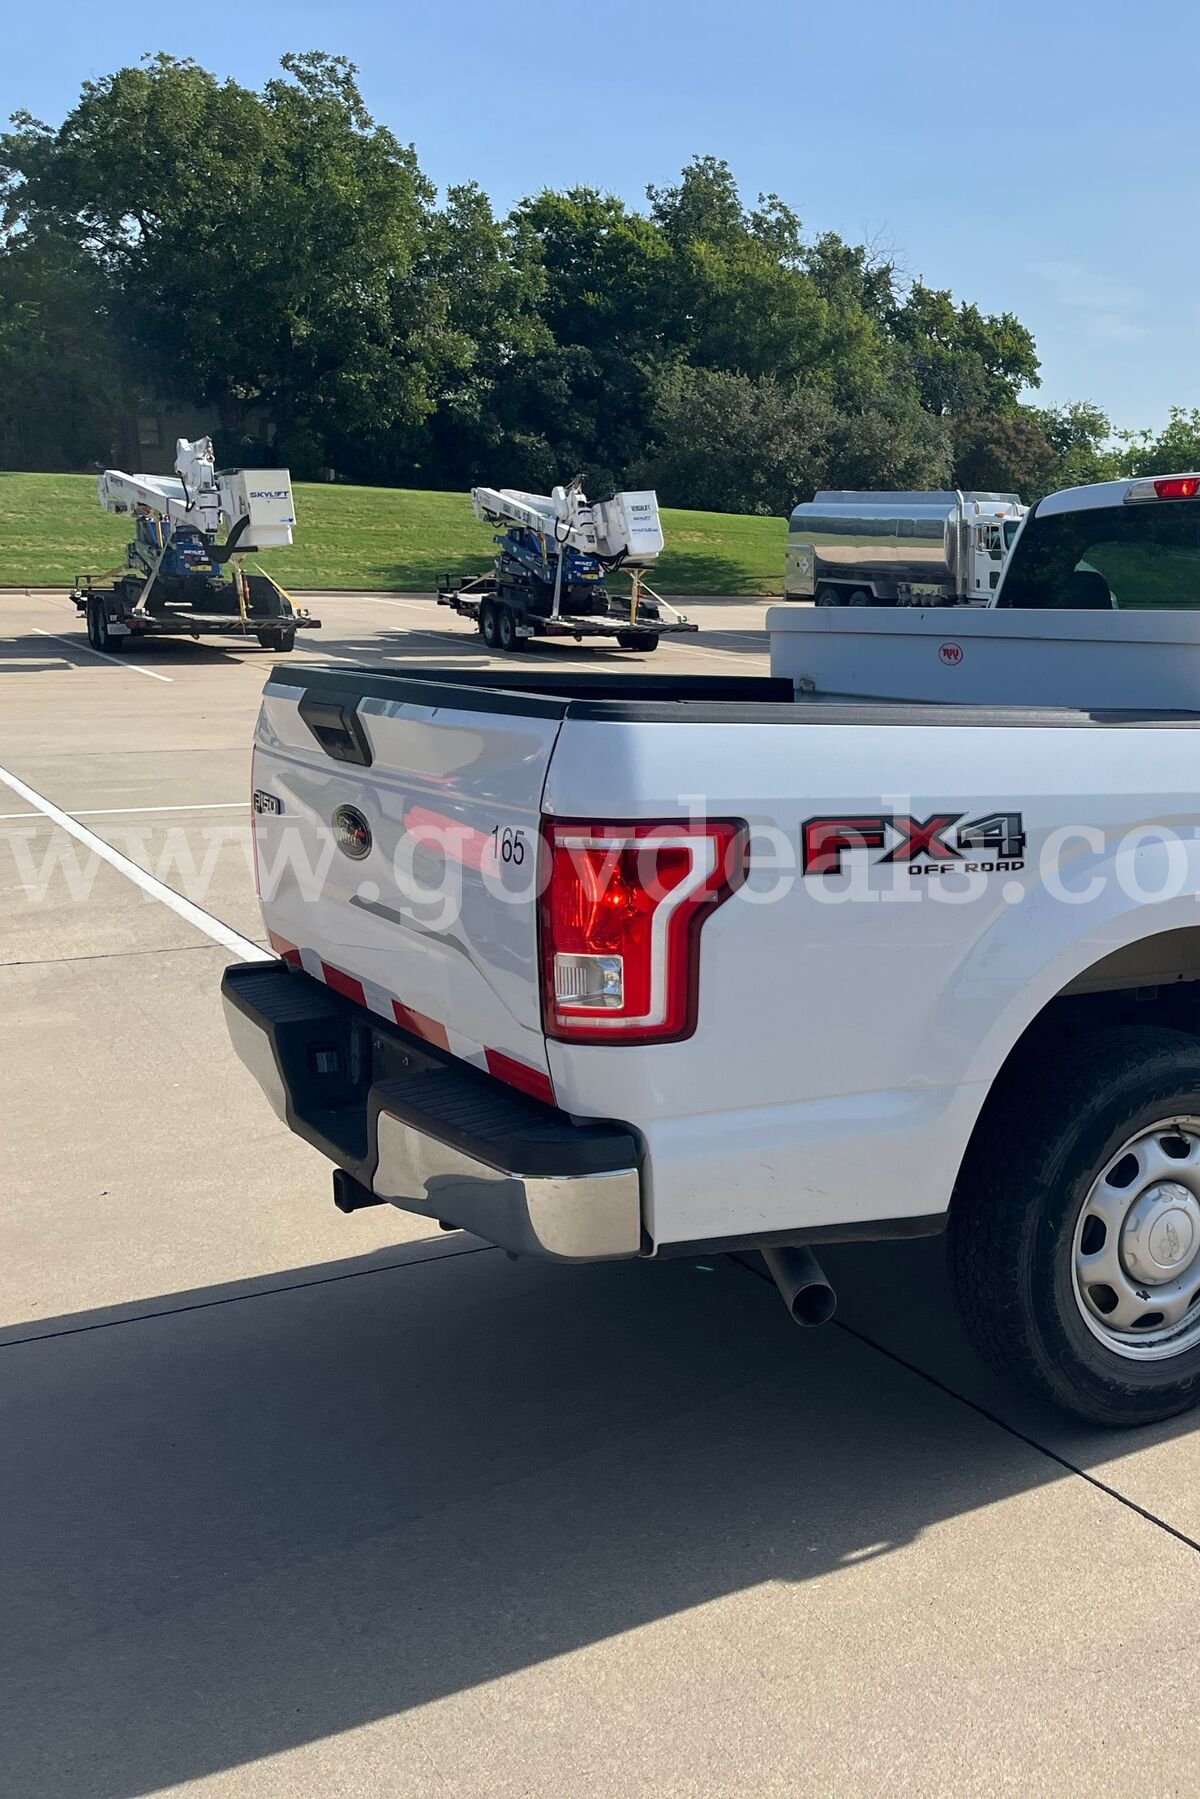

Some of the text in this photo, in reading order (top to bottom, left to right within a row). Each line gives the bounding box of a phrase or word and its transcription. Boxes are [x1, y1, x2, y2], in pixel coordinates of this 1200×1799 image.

[249, 490, 290, 500] SKYLIFT
[491, 824, 525, 866] 165
[801, 812, 1025, 876] FX4
[907, 861, 1025, 876] OFF ROAD
